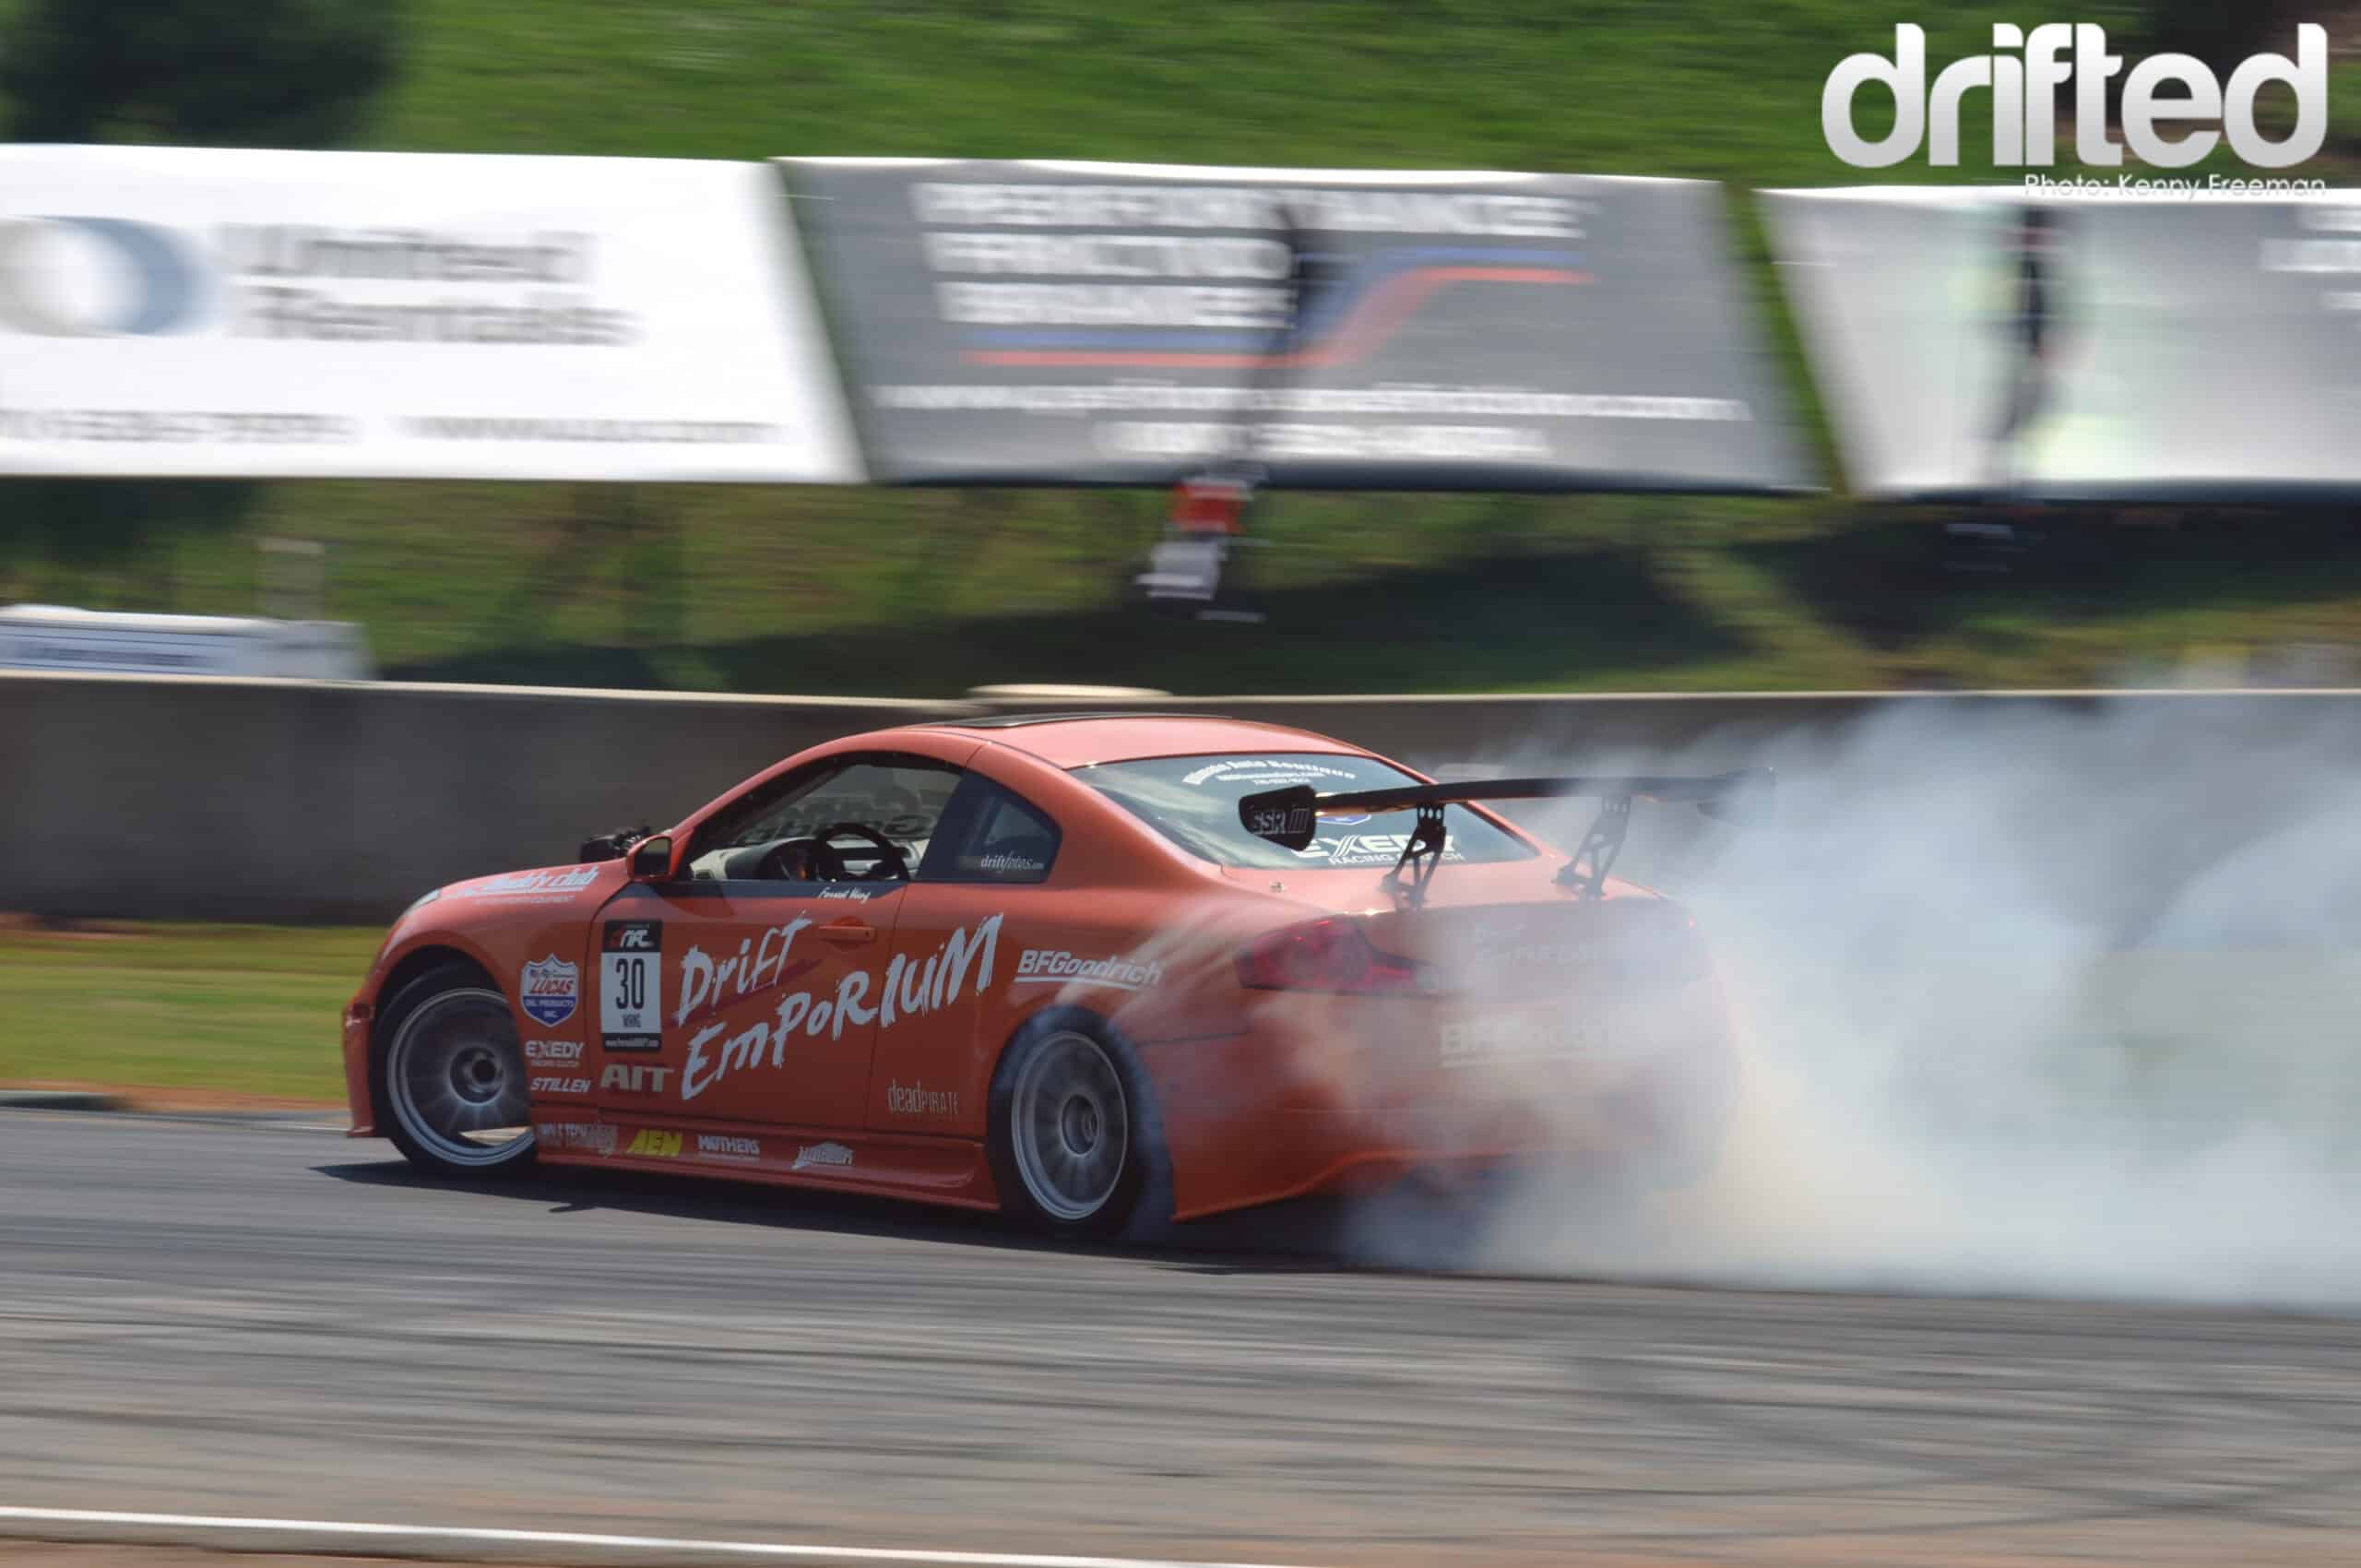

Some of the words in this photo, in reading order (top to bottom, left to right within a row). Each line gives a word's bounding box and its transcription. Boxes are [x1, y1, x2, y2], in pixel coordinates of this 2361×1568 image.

[1017, 949, 1162, 986] BFGoodrich
[529, 979, 575, 995] LUCAS
[616, 958, 645, 1010] 30
[525, 1040, 584, 1058] EXEDY
[530, 1077, 591, 1093] STILLEN
[599, 1063, 675, 1093] AIT
[697, 1135, 760, 1155] MOTHERS
